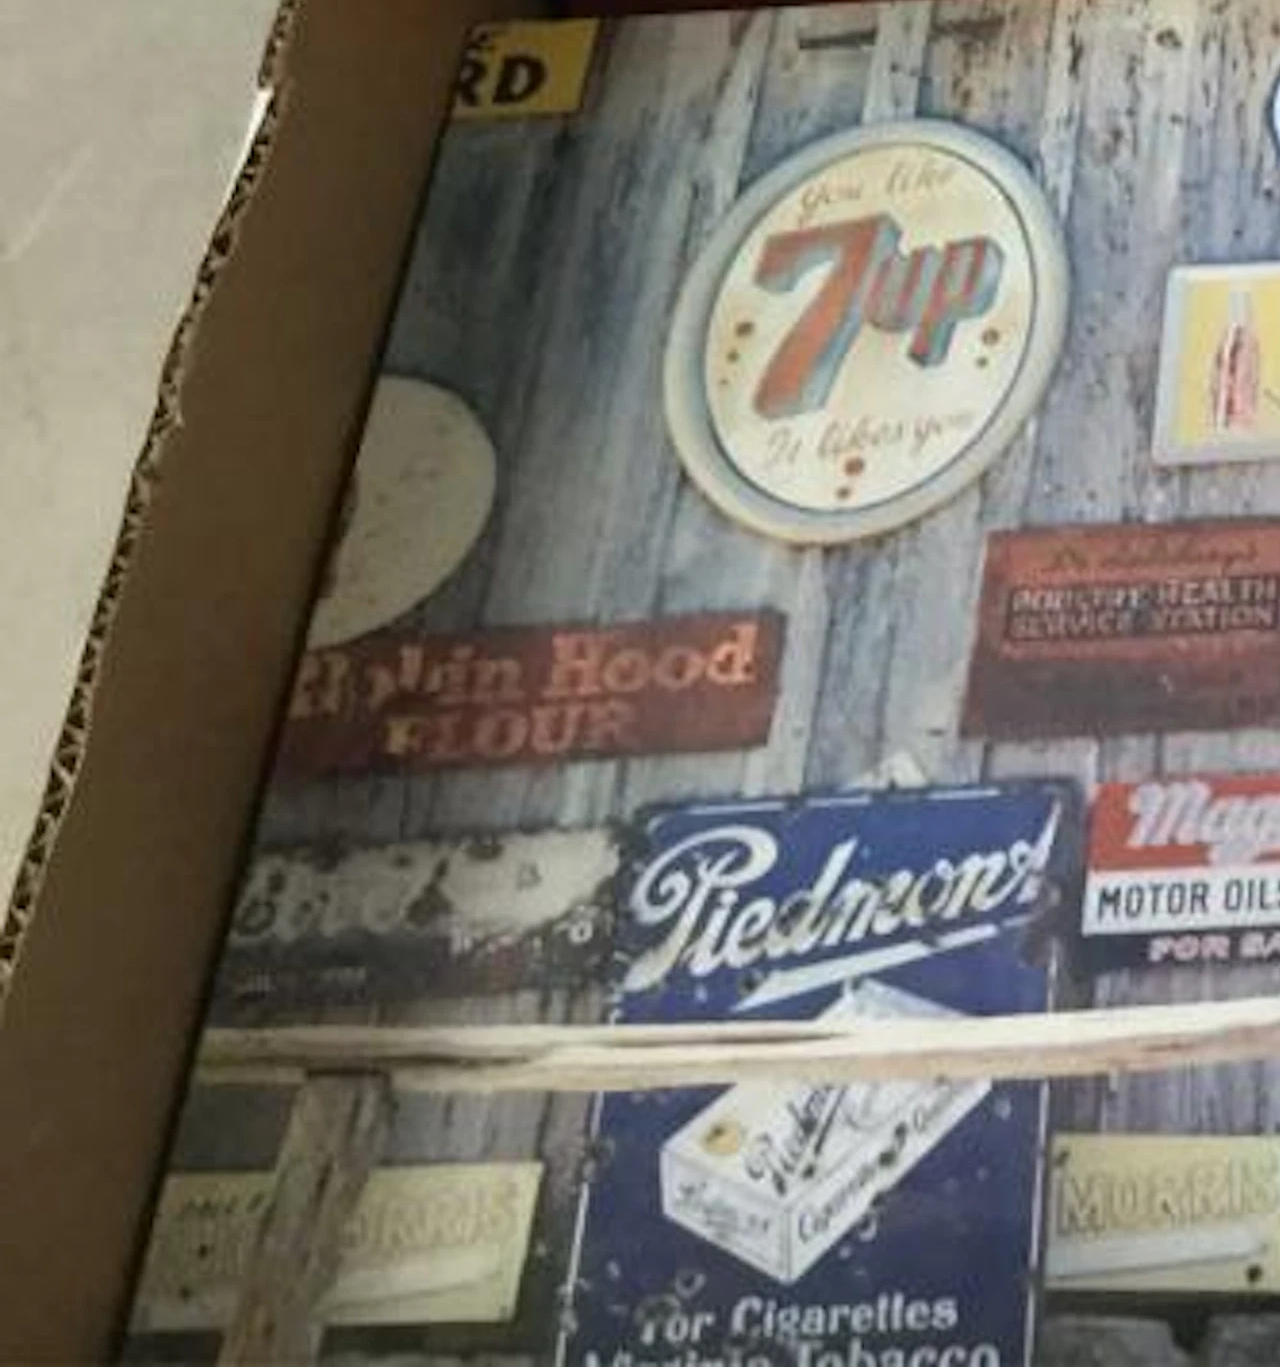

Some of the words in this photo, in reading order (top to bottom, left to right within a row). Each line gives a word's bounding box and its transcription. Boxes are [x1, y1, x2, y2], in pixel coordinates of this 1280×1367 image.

[545, 622, 758, 701] Hood
[1098, 879, 1210, 920] MOTOR
[1148, 933, 1232, 963] FOR
[730, 1291, 959, 1339] Cigarettes
